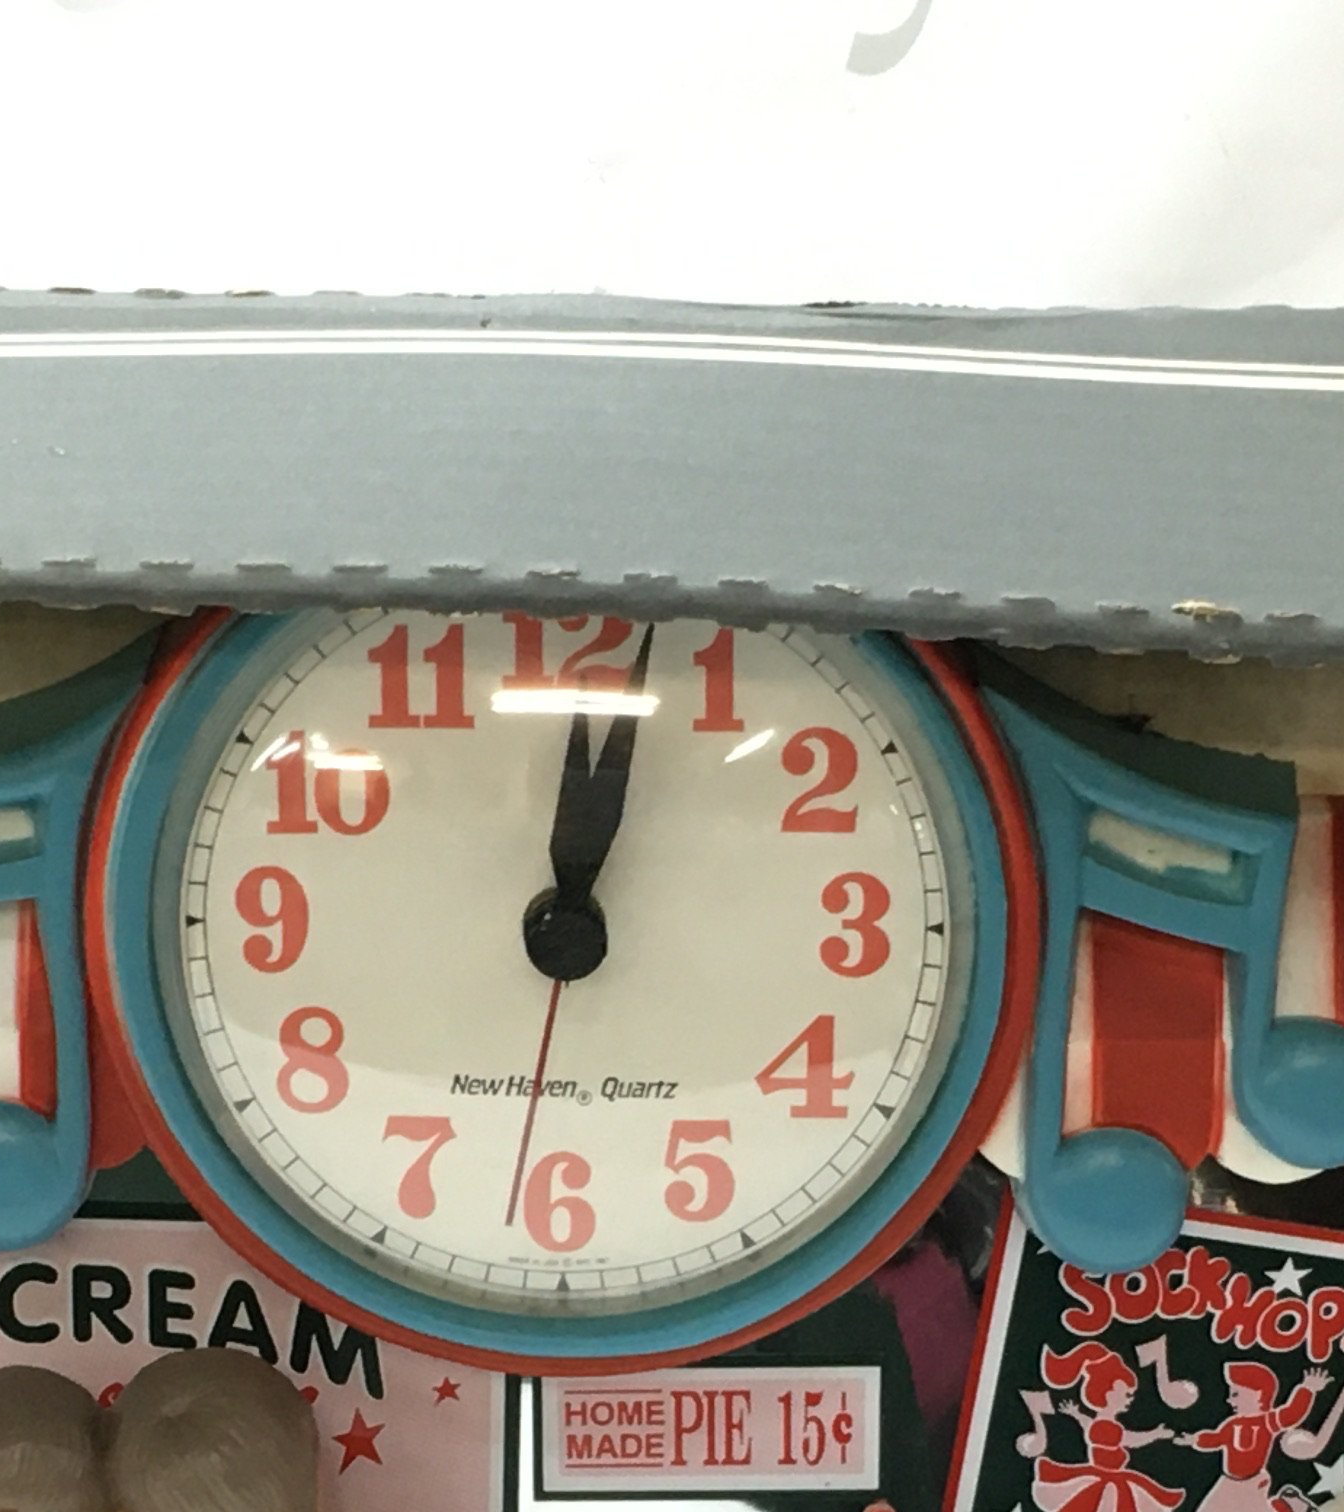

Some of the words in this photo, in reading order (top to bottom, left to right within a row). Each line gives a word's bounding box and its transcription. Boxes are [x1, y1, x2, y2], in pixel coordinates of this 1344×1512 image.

[368, 624, 474, 728] 11
[693, 627, 744, 731] 1
[266, 730, 390, 835] 10
[780, 727, 858, 833] 2
[235, 866, 309, 973] 9
[819, 872, 891, 977] 3
[276, 1007, 350, 1113] 8
[450, 1074, 503, 1096] New
[601, 1077, 679, 1102] Quartz
[755, 1015, 855, 1118] 4
[382, 1116, 456, 1219] 7
[523, 1152, 596, 1252] 6
[664, 1120, 735, 1222] 5
[1058, 1245, 1230, 1336] SOCK
[564, 1401, 665, 1427] HOME
[565, 1432, 665, 1460] MADE
[670, 1389, 753, 1467] PIE
[777, 1389, 853, 1467] 15¢
